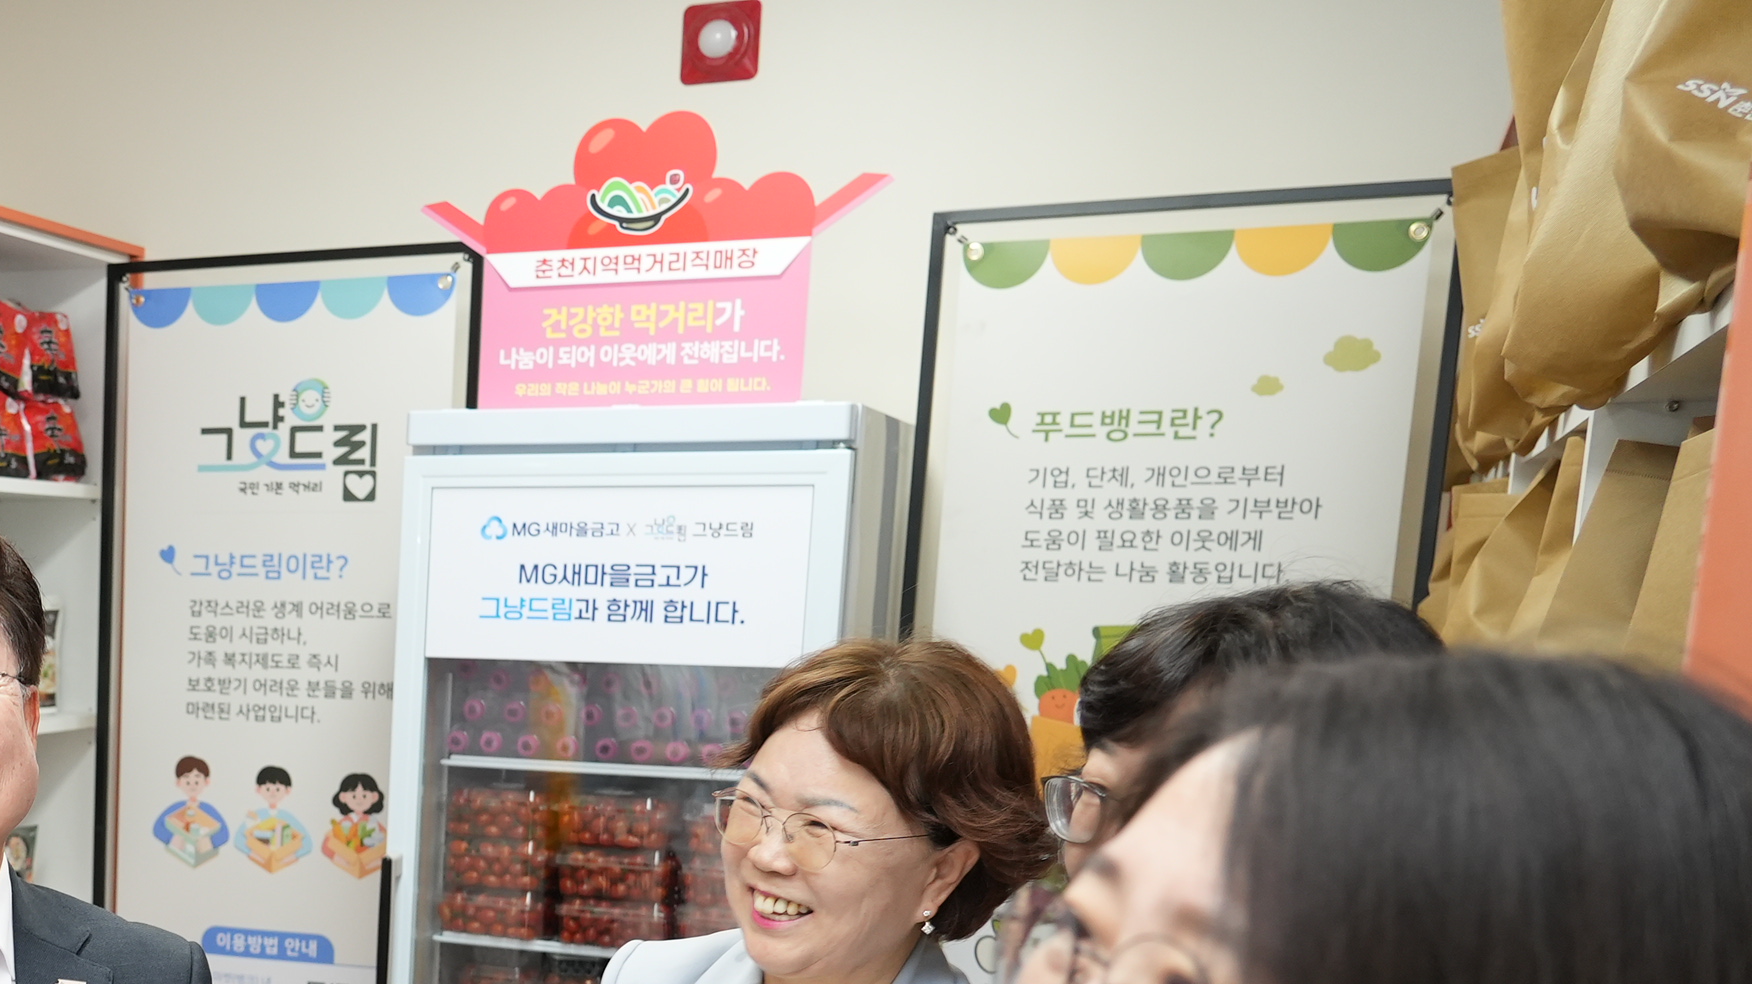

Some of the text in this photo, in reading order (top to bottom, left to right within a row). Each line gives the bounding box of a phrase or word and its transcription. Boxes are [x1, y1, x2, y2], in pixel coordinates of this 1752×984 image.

[534, 247, 759, 280] 춘천지역먹거리직매장
[541, 298, 745, 341] 건강한 먹거리가
[499, 337, 786, 371] 나눔이 되어 이웃에게 전해집니다.
[514, 382, 552, 398] 우리의
[555, 381, 580, 397] 작은
[625, 379, 676, 395] 누군가의
[1031, 406, 1225, 443] 푸드뱅크란?
[1027, 463, 1286, 489] 기업, 단체, 개인으로부터
[1024, 495, 1322, 520] 식품 및 생활용품을 기부받아
[692, 521, 754, 539] 그냥드림
[1021, 528, 1263, 552] 도움이 필요한 이웃에게
[190, 551, 349, 581] 그냥드림이란?
[518, 562, 708, 589] MG새마을금고가
[1019, 559, 1107, 583] 전달하는
[1114, 560, 1158, 584] 나눔
[189, 599, 393, 620] 갑작스러운 생계 어려움으로
[479, 596, 745, 625] 그냥드림과 함께 합니다.
[188, 625, 308, 646] 도움이 시급하나,
[187, 650, 340, 673] 가족 복지제도로 즉시
[186, 676, 394, 701] 보호받기 어려운 분들을 위해
[186, 701, 321, 724] 마련된 사업입니다.
[216, 932, 318, 958] 이용방법 안내
